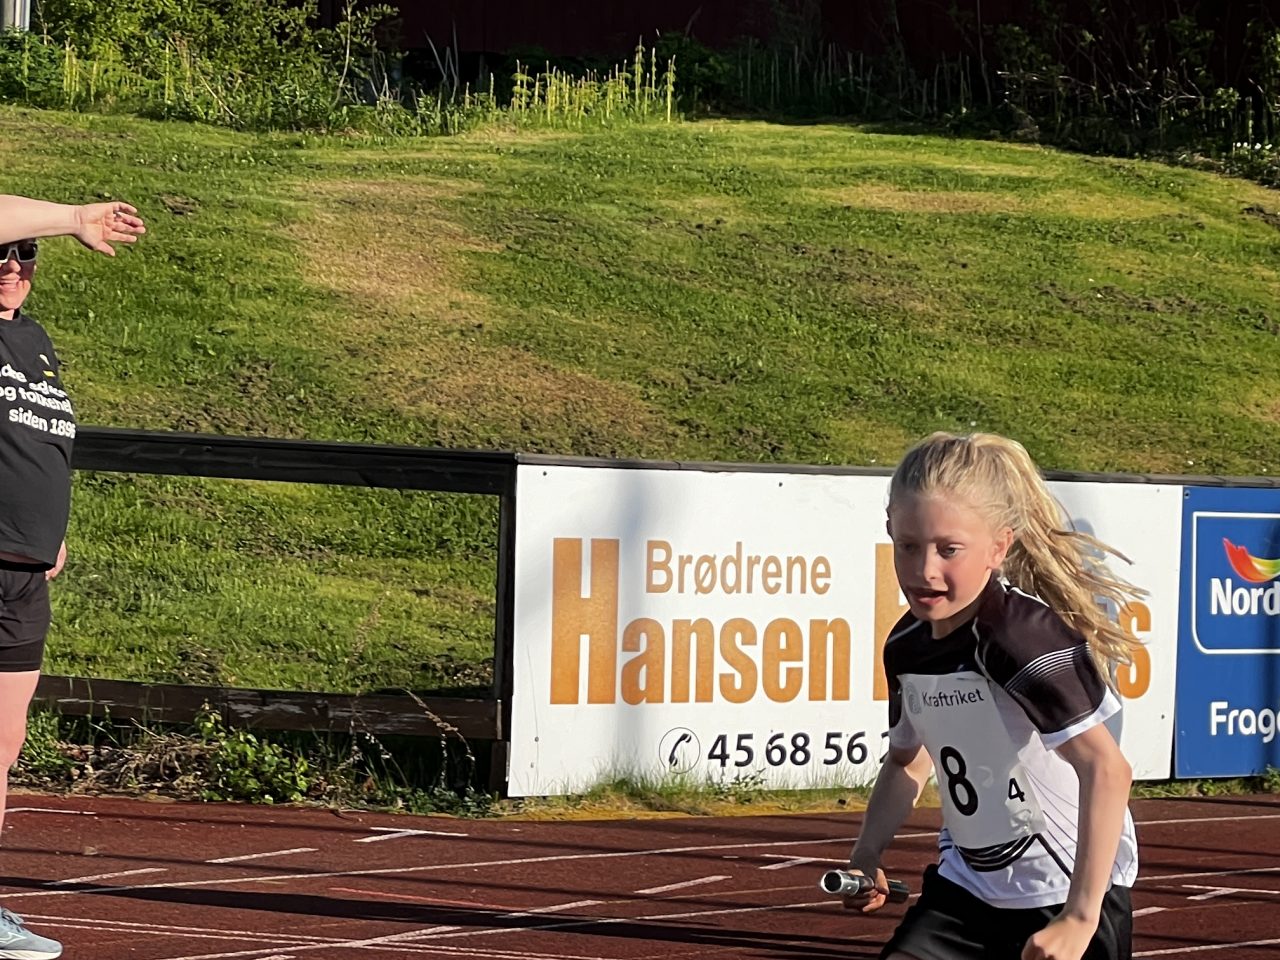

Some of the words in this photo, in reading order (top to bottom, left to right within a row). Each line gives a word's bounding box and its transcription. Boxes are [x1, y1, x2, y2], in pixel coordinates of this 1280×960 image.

[9, 407, 48, 431] siden
[645, 540, 832, 595] Brødrene
[549, 538, 851, 705] Hansen
[921, 688, 985, 708] Kraftriket
[707, 733, 755, 767] 45
[765, 732, 811, 766] 68
[823, 731, 868, 765] 56
[940, 746, 979, 816] 8
[1008, 778, 1026, 803] 4
